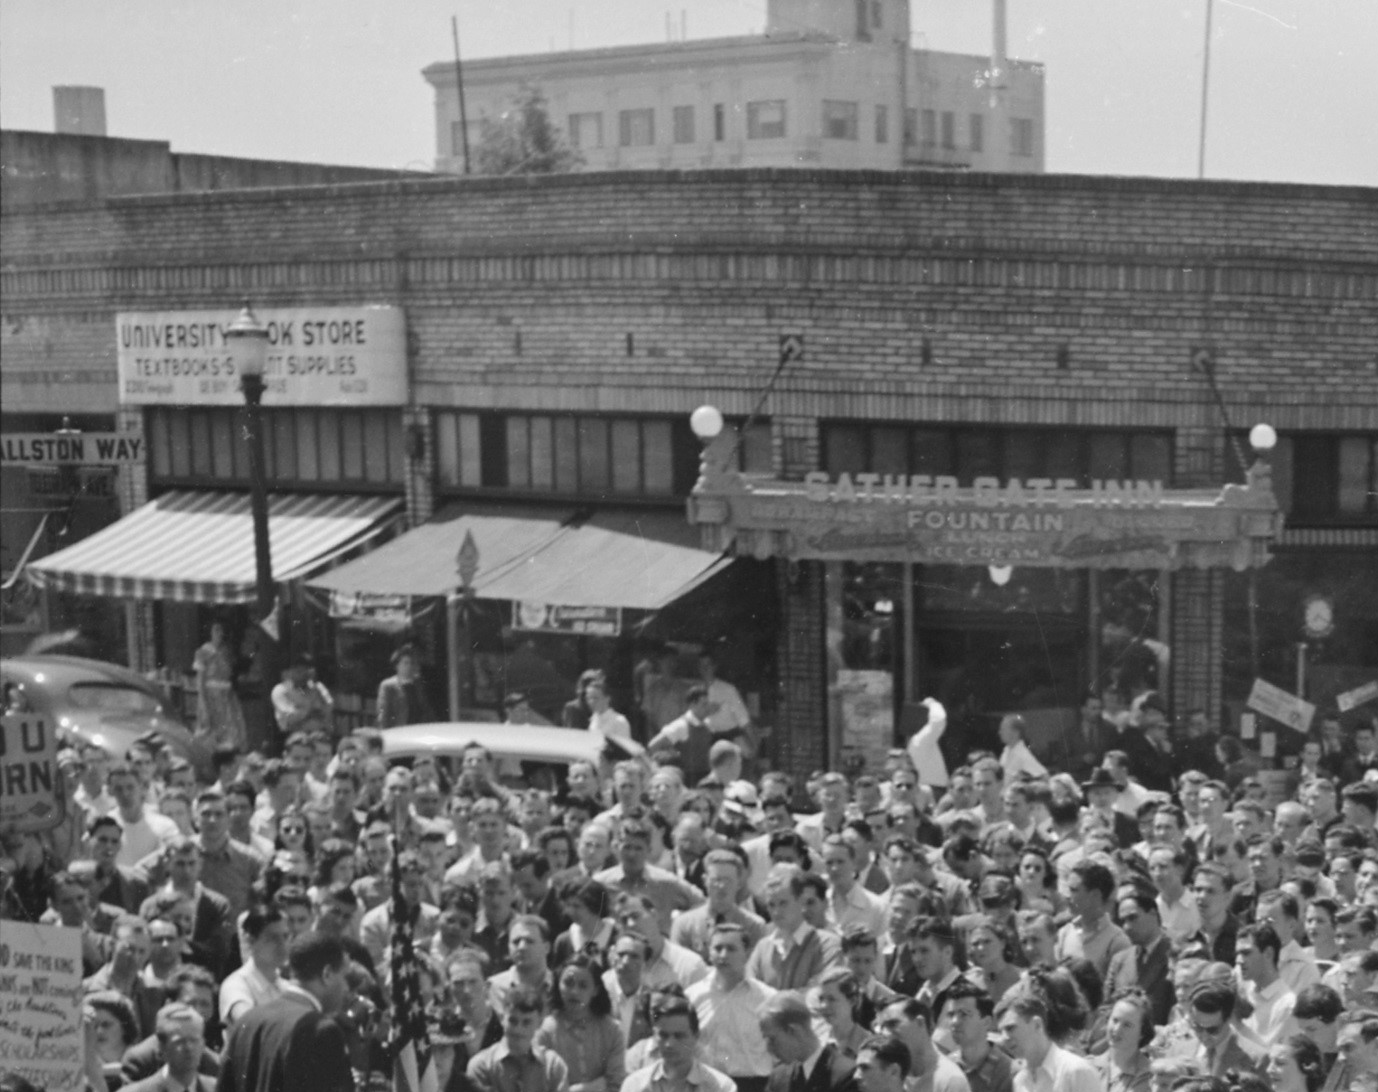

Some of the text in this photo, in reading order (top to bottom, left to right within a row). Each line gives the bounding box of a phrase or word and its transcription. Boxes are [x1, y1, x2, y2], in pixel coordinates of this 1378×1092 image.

[121, 323, 230, 349] UNIVERSITY
[302, 320, 366, 346] STORE
[136, 357, 220, 377] TEXTBOOKS
[287, 355, 356, 376] SUPPLIES
[96, 438, 141, 461] WAY
[804, 471, 1162, 509] SATHER GATE INN
[906, 509, 1064, 531] FOUNTAIN
[21, 720, 45, 753] U
[0, 761, 51, 796] RN
